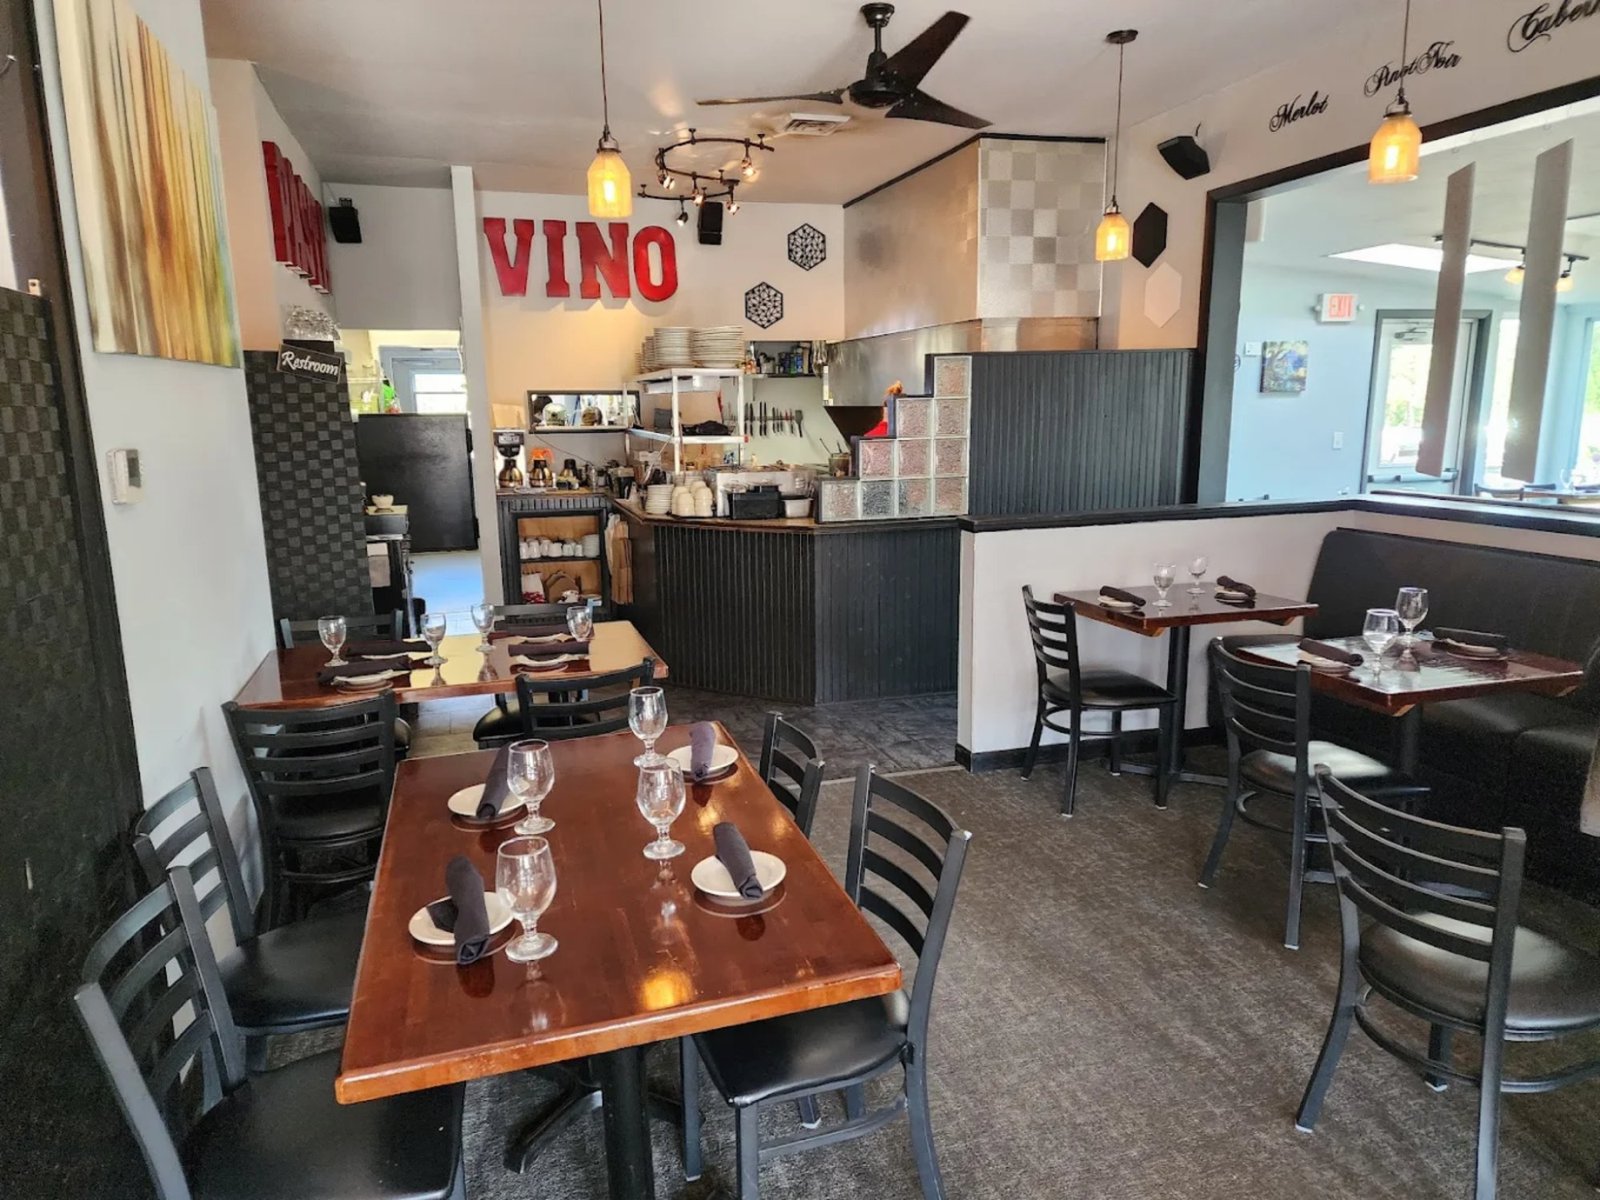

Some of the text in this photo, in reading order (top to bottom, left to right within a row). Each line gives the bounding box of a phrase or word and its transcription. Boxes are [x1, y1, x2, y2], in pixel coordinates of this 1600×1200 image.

[1364, 40, 1462, 98] Pinot Noir
[1268, 90, 1330, 132] Merlot
[482, 216, 679, 303] VINO
[1328, 295, 1354, 318] EXIT
[281, 350, 339, 376] Restroom
